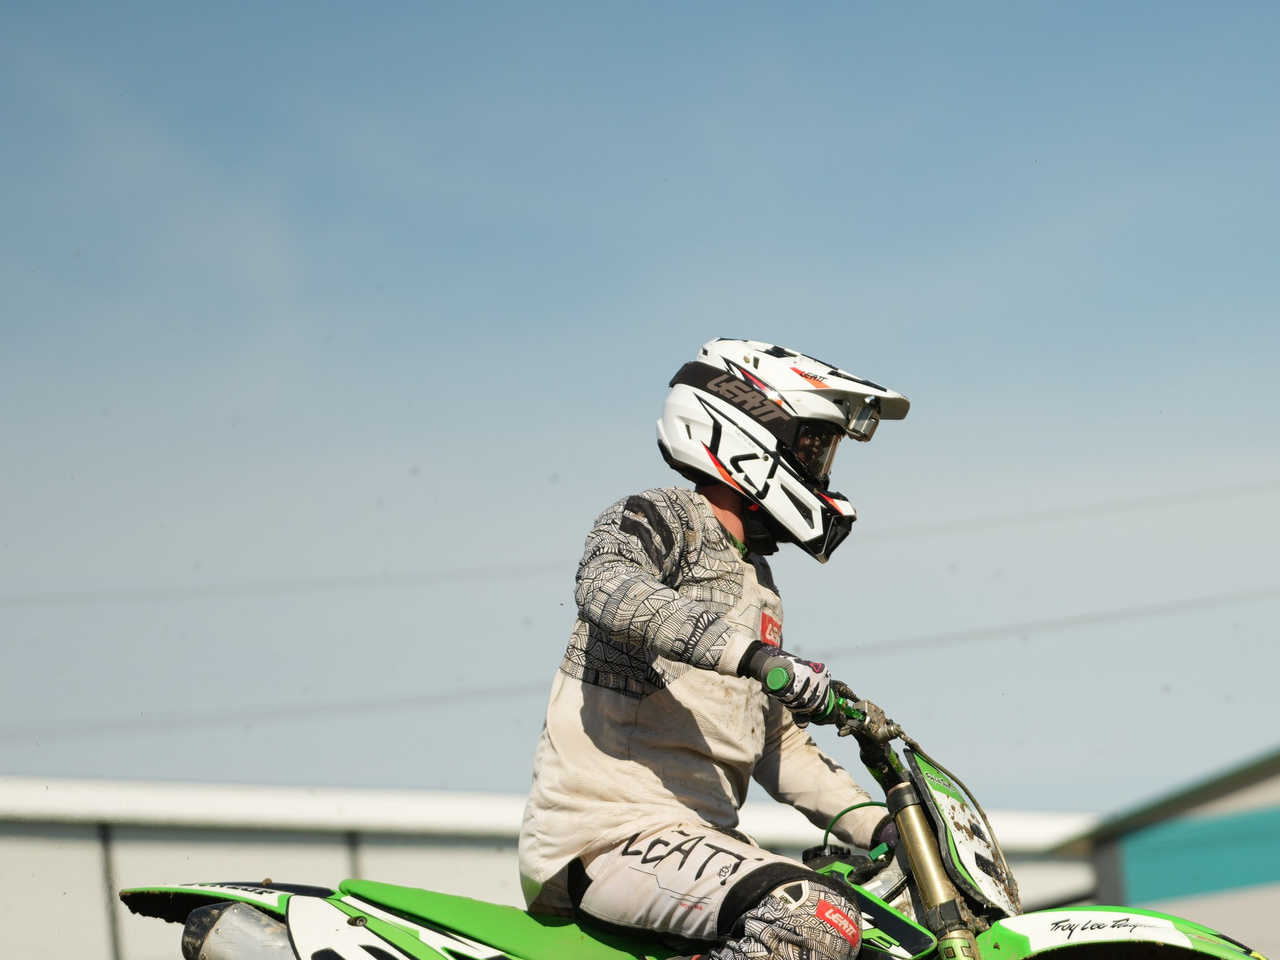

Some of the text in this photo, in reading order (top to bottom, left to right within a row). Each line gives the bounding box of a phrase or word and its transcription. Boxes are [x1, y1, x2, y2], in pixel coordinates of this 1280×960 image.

[800, 371, 828, 383] LEATT
[706, 373, 792, 422] LEATT
[824, 908, 857, 936] LEATT
[1050, 918, 1081, 940] Troy
[1080, 919, 1108, 931] Lee
